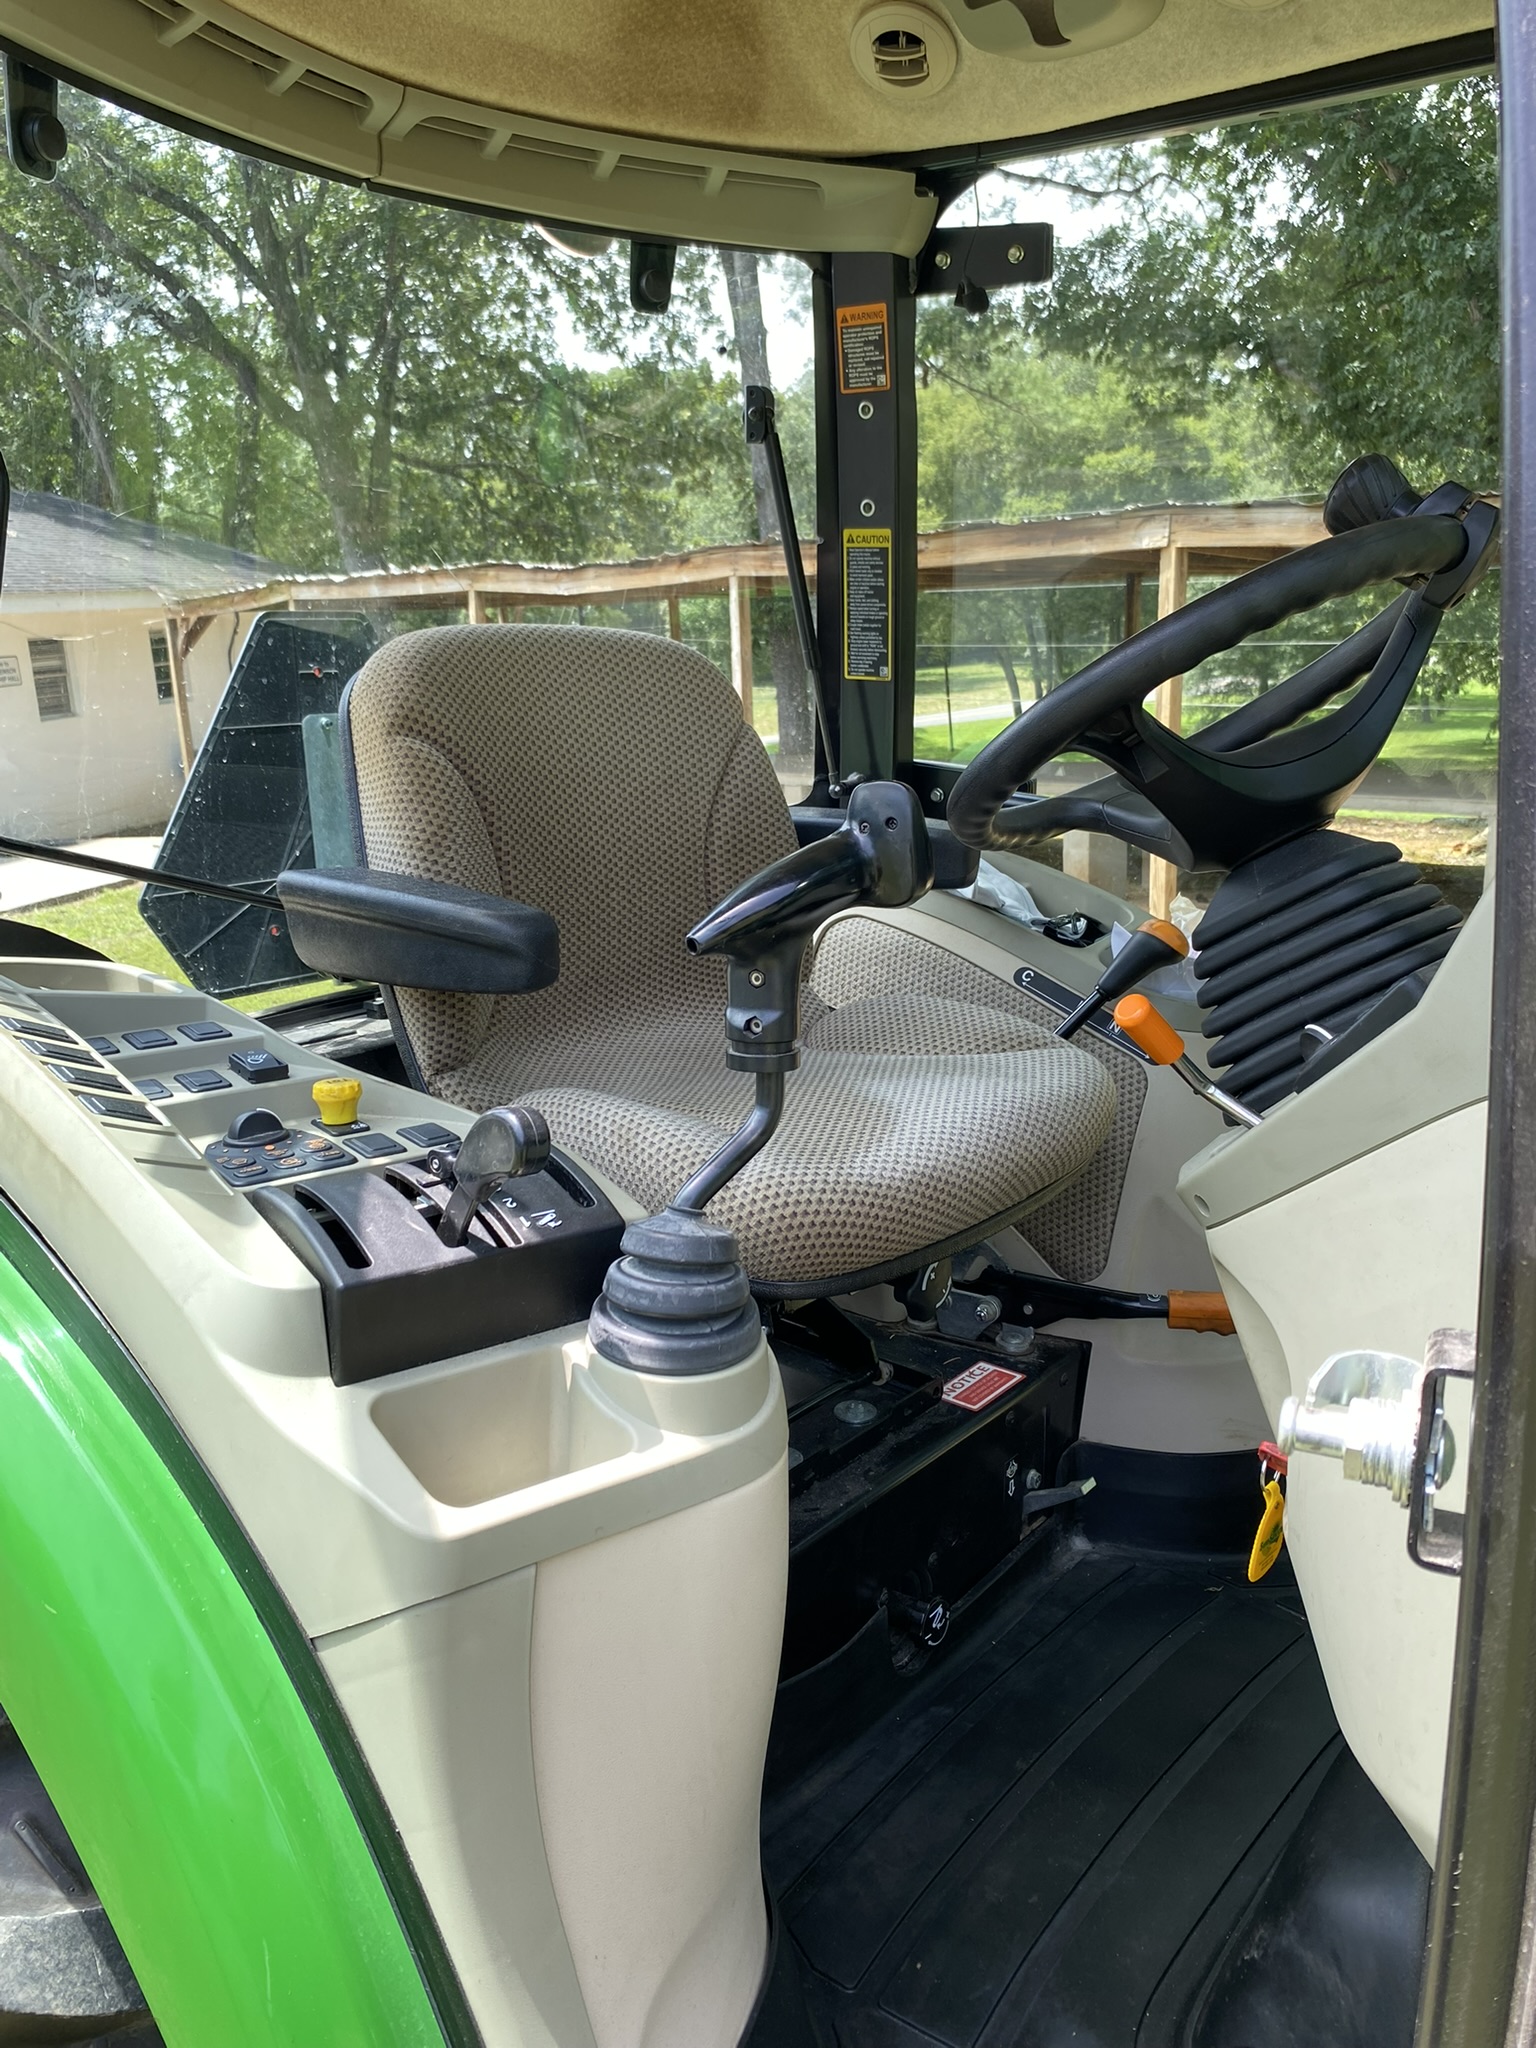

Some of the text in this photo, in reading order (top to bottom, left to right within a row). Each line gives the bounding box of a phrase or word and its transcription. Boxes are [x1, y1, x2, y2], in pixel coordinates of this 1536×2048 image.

[849, 310, 884, 322] WARNING
[855, 535, 890, 544] CAUTION
[1021, 970, 1034, 982] C
[942, 1365, 991, 1397] NOTICE
